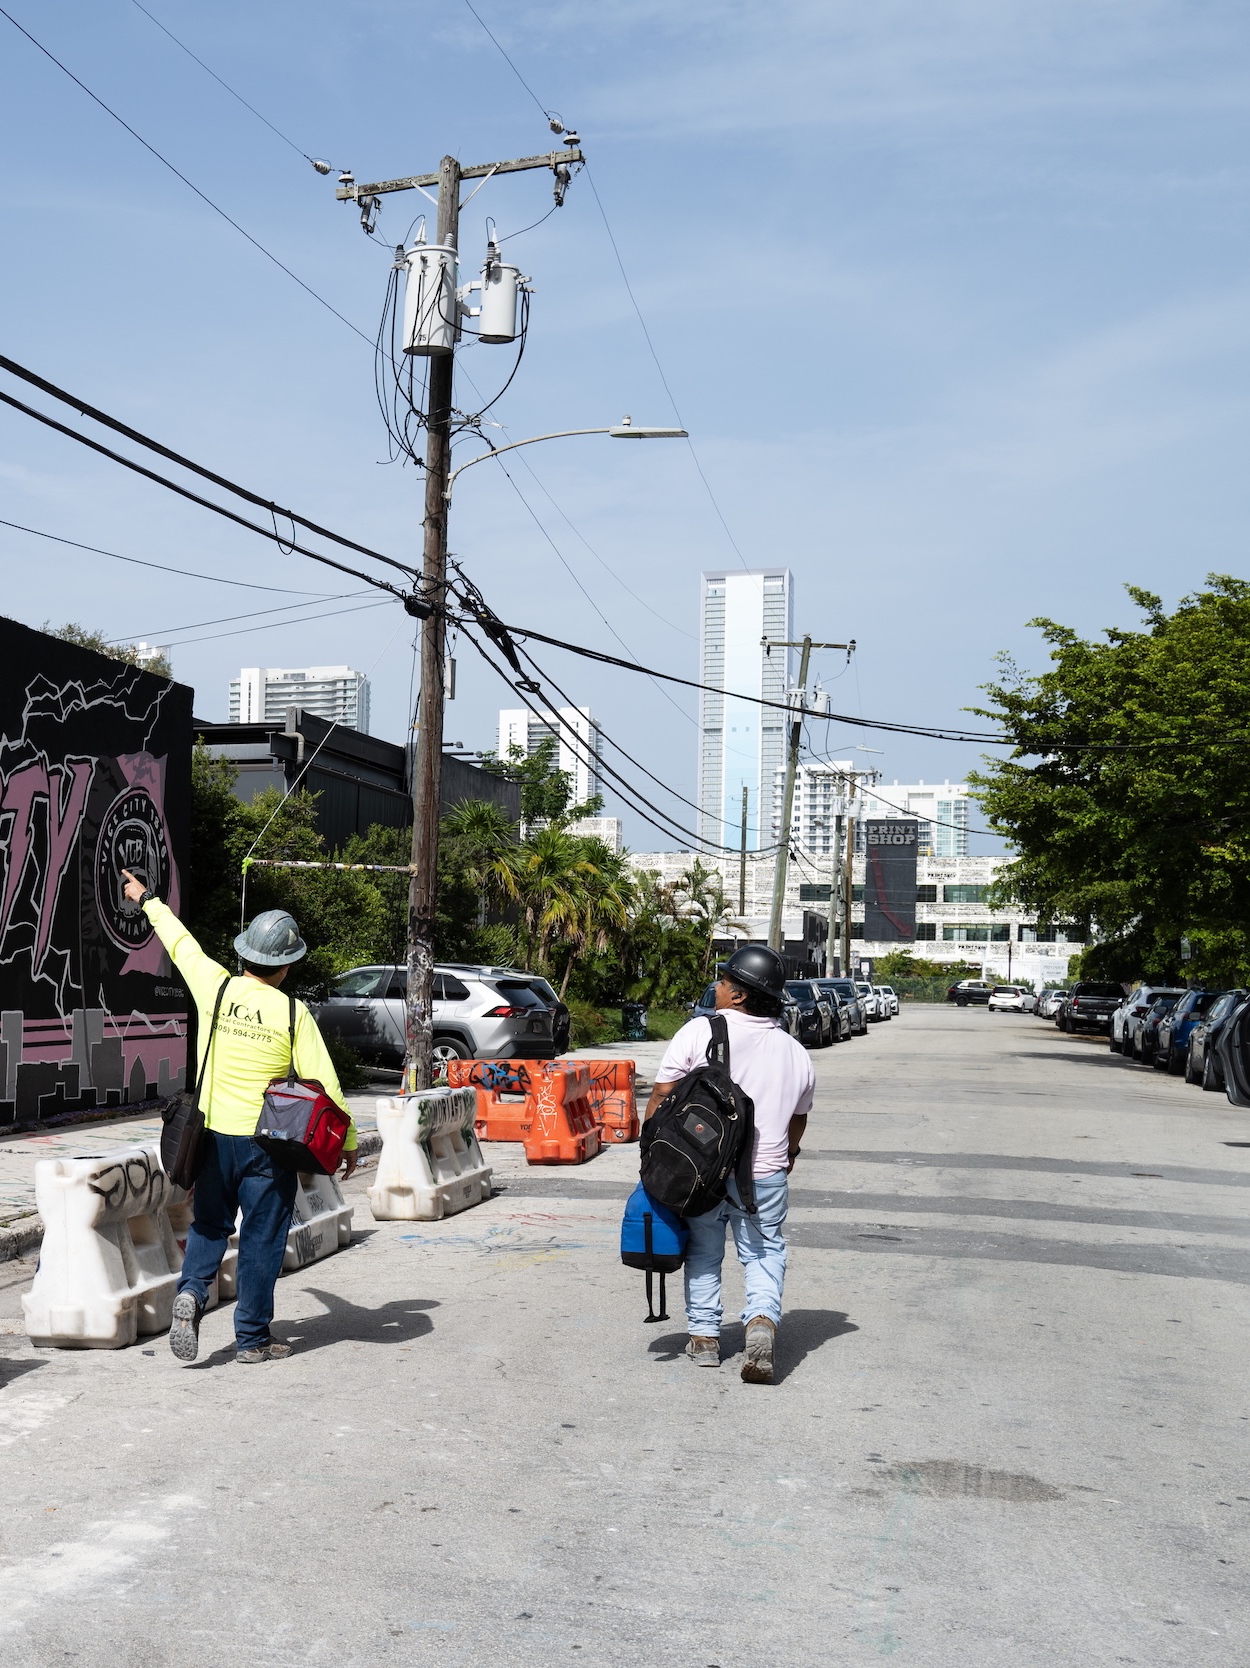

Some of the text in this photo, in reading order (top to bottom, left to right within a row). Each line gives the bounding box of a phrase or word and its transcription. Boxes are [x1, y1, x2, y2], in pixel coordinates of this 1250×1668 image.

[122, 798, 147, 818] CITY
[868, 825, 916, 834] PRINT
[867, 834, 916, 845] SHOP
[118, 917, 148, 936] MIAM
[222, 1001, 264, 1025] JC&A
[213, 1022, 272, 1043] 305) 594-2775
[232, 1019, 271, 1034] Contractors
